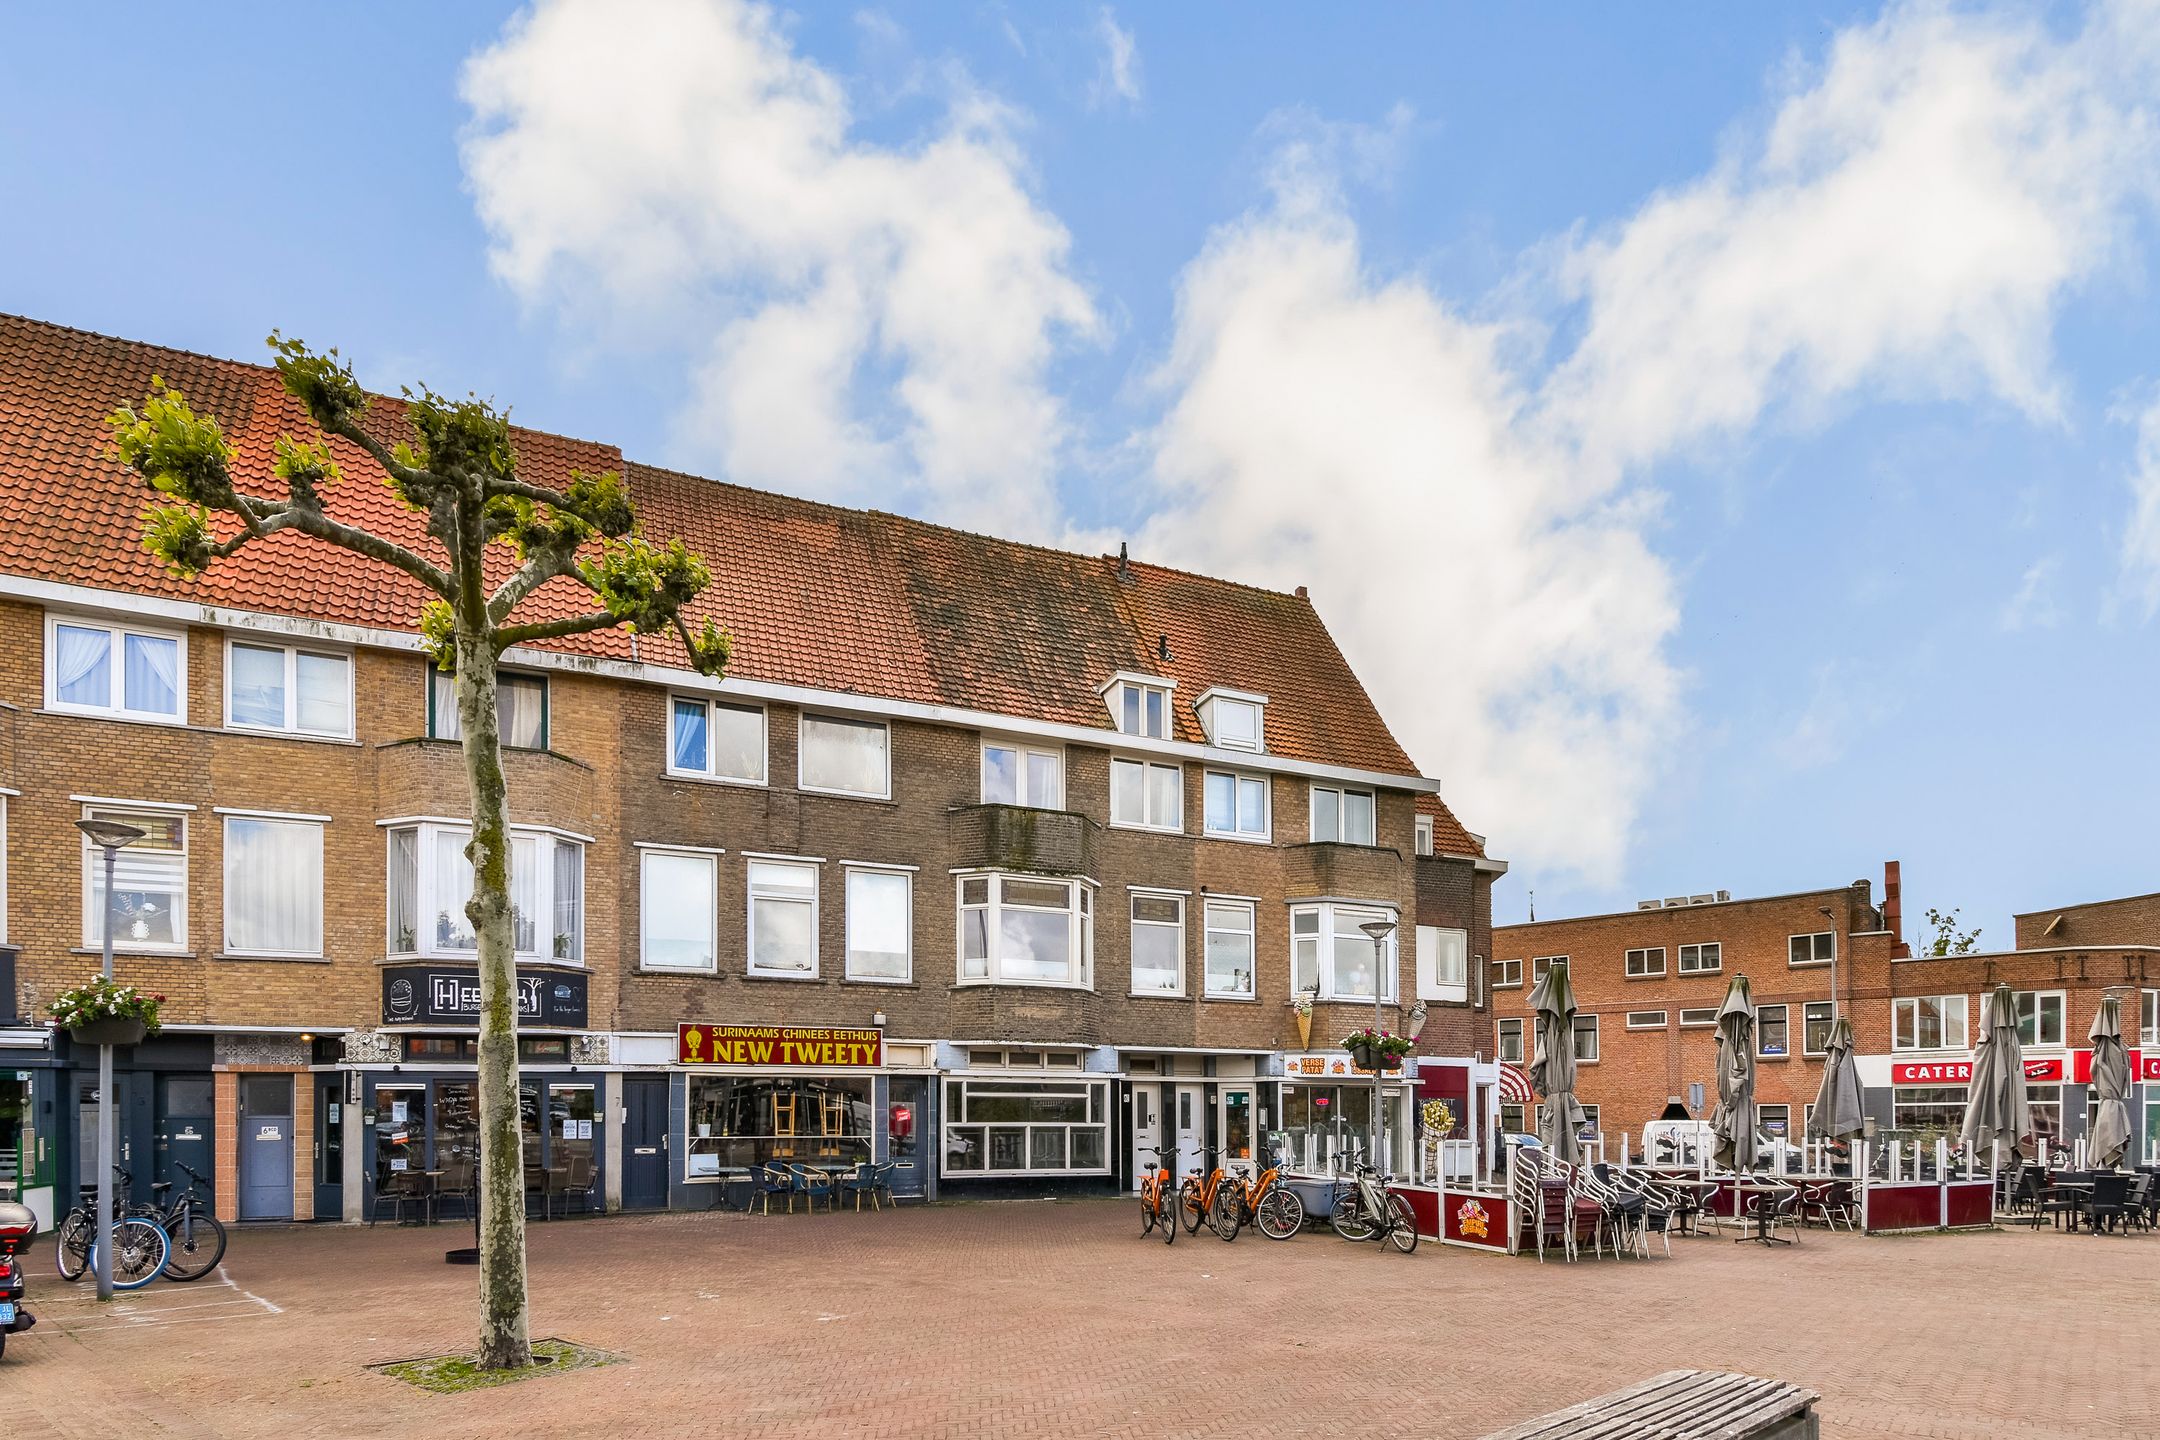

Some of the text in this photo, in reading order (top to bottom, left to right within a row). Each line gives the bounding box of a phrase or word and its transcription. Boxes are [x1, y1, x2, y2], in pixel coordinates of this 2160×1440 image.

[712, 1027, 878, 1041] SURINAAMS CHINEES EETHUIS
[712, 1040, 877, 1065] NEW TWEETY
[1301, 1058, 1325, 1067] VERSE
[2151, 1061, 2160, 1075] C
[1301, 1066, 1324, 1075] PATAT
[1905, 1065, 1970, 1079] CATER
